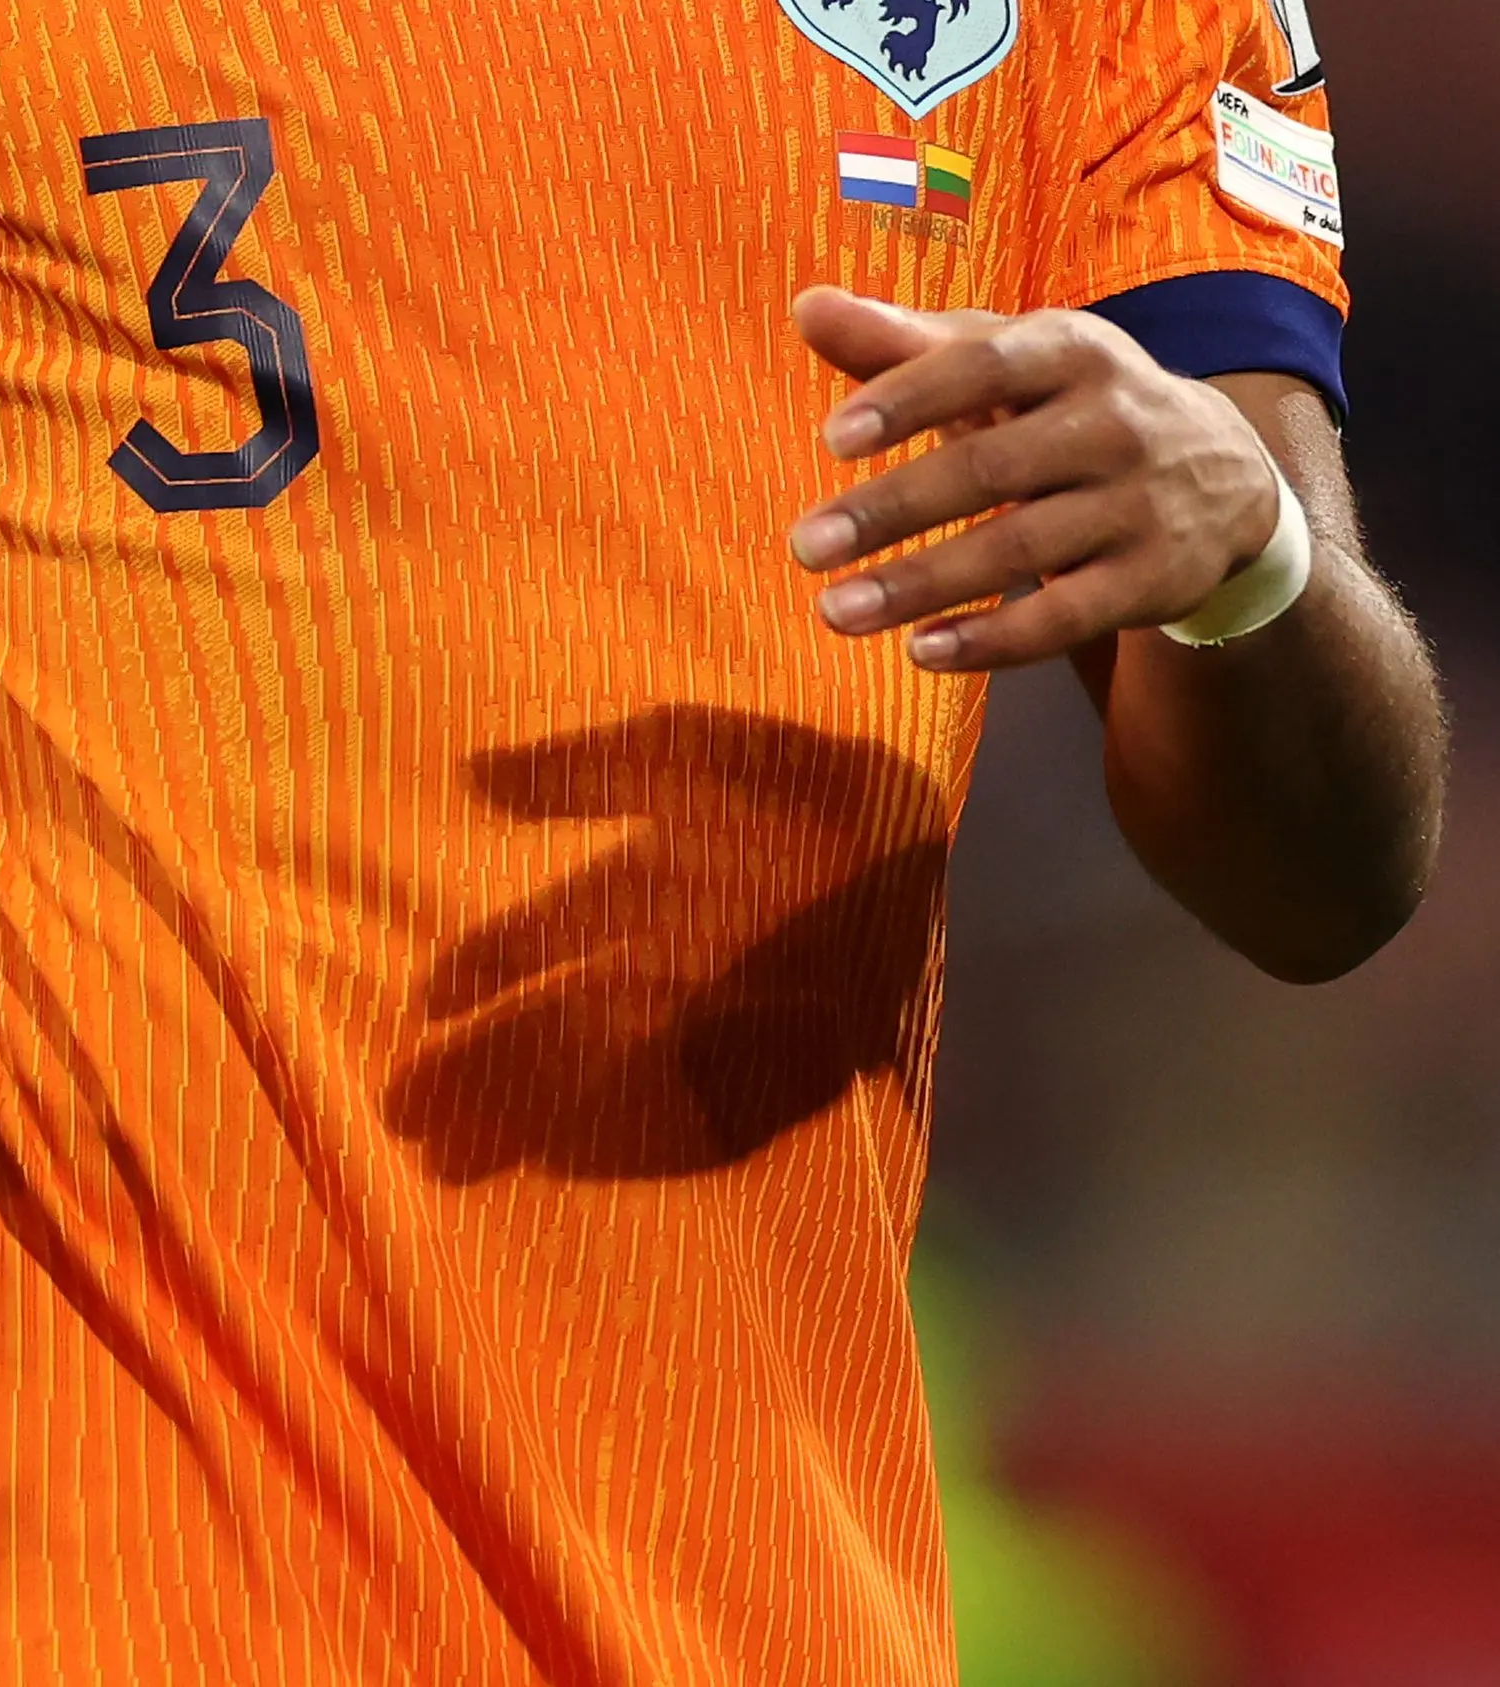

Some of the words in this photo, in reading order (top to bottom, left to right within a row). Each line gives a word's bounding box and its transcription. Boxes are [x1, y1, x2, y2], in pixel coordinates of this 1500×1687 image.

[1216, 87, 1250, 119] UEFA
[1303, 205, 1317, 227] for
[79, 118, 320, 513] 3
